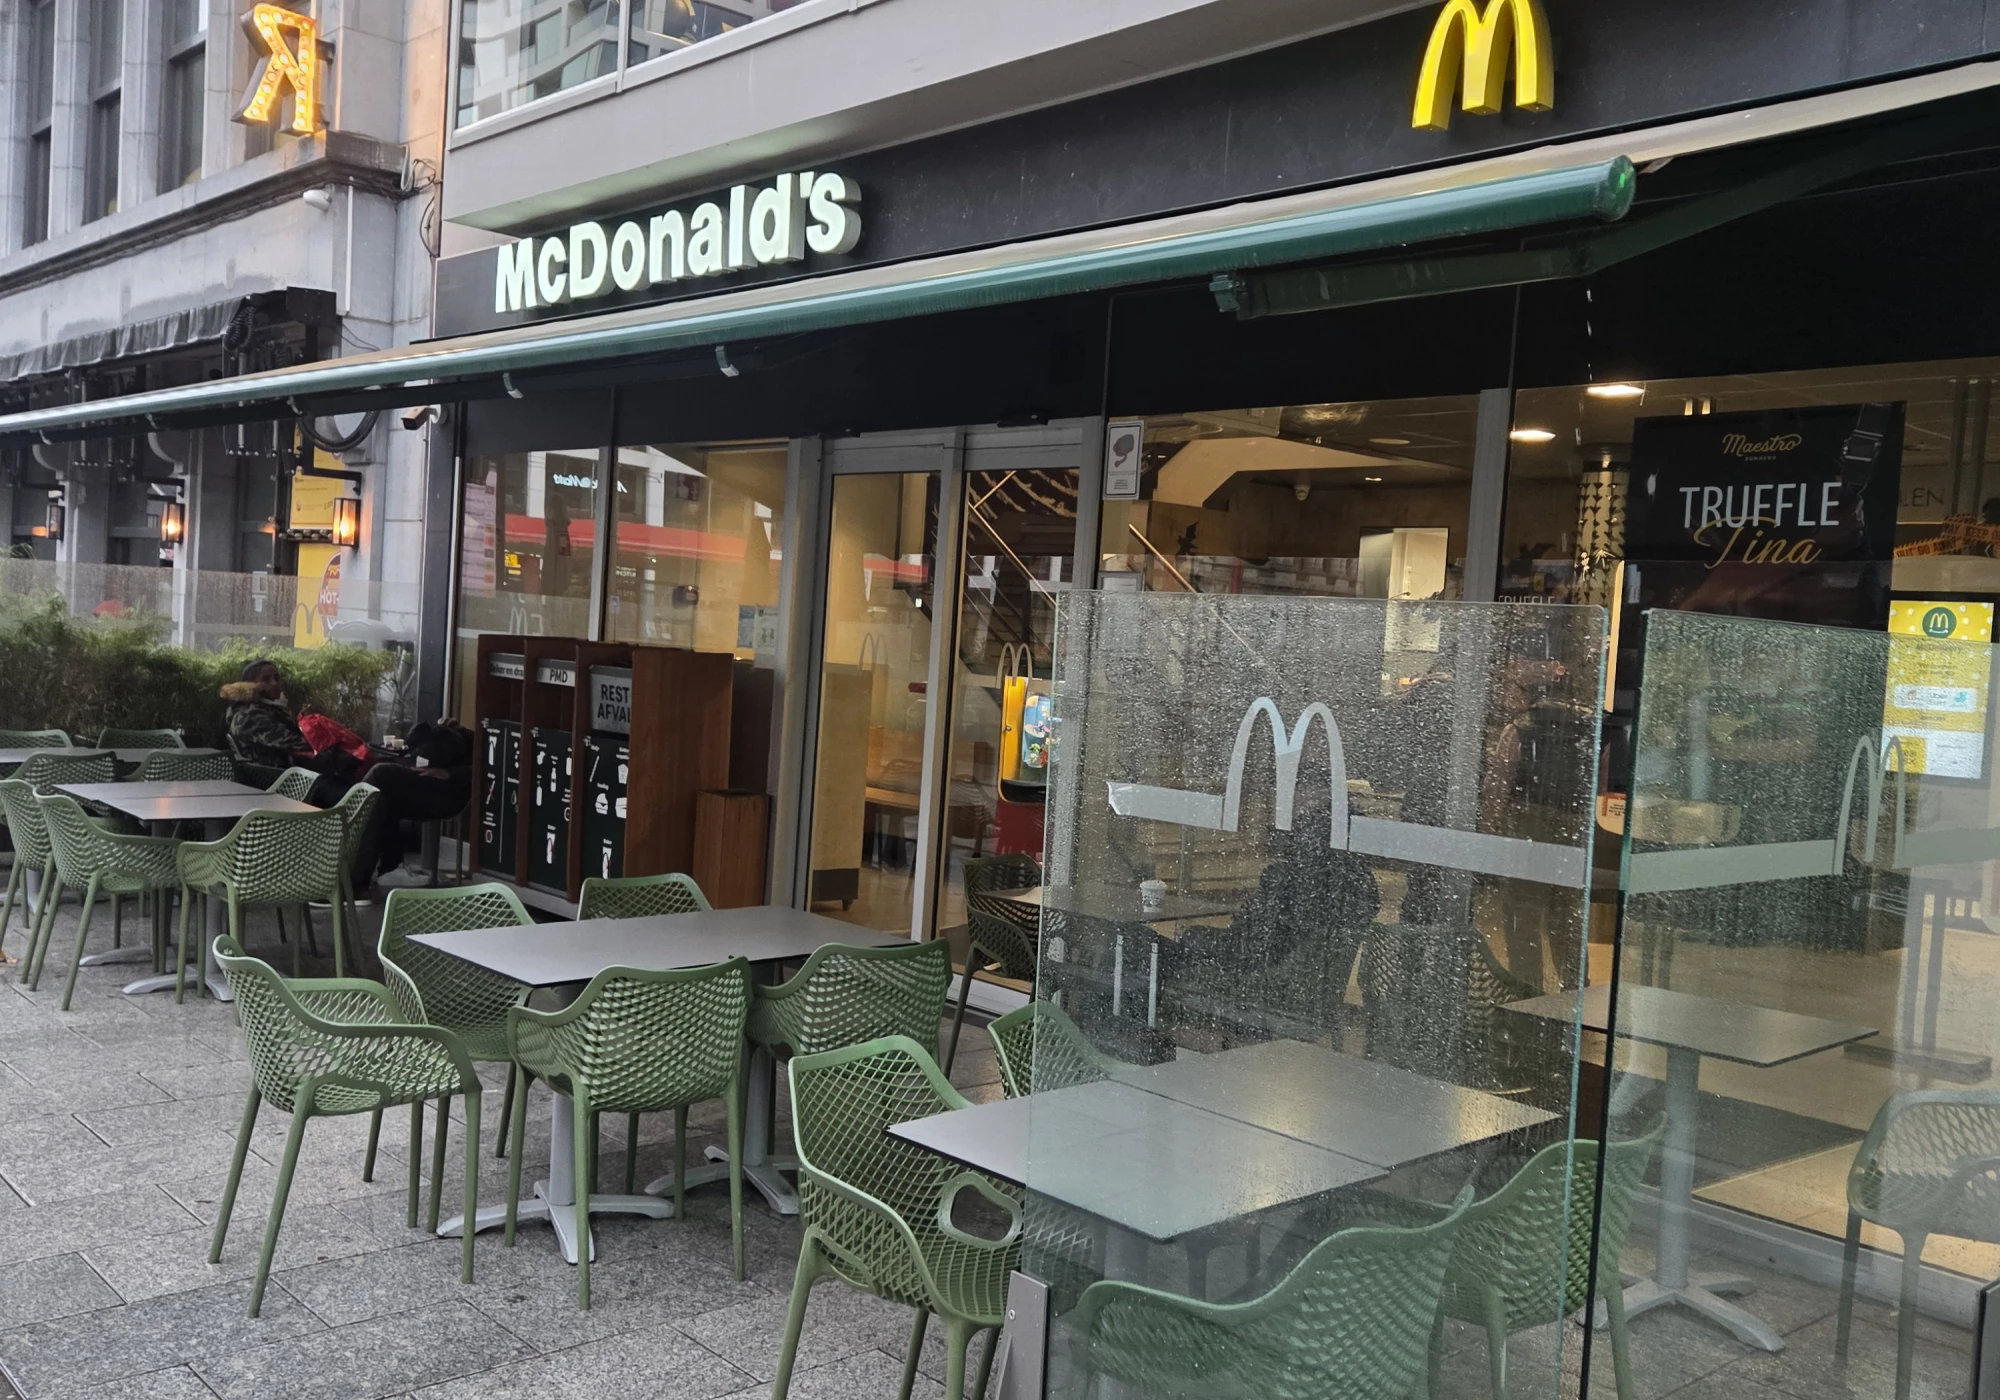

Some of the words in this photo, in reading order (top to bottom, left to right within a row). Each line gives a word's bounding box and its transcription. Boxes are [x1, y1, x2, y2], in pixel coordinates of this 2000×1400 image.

[495, 171, 857, 313] McDonald's
[1722, 433, 1802, 457] Maestro
[1679, 482, 1843, 528] TRUFFLE
[1693, 516, 1822, 569] Tina
[550, 669, 568, 683] PMD
[601, 684, 629, 704] REST
